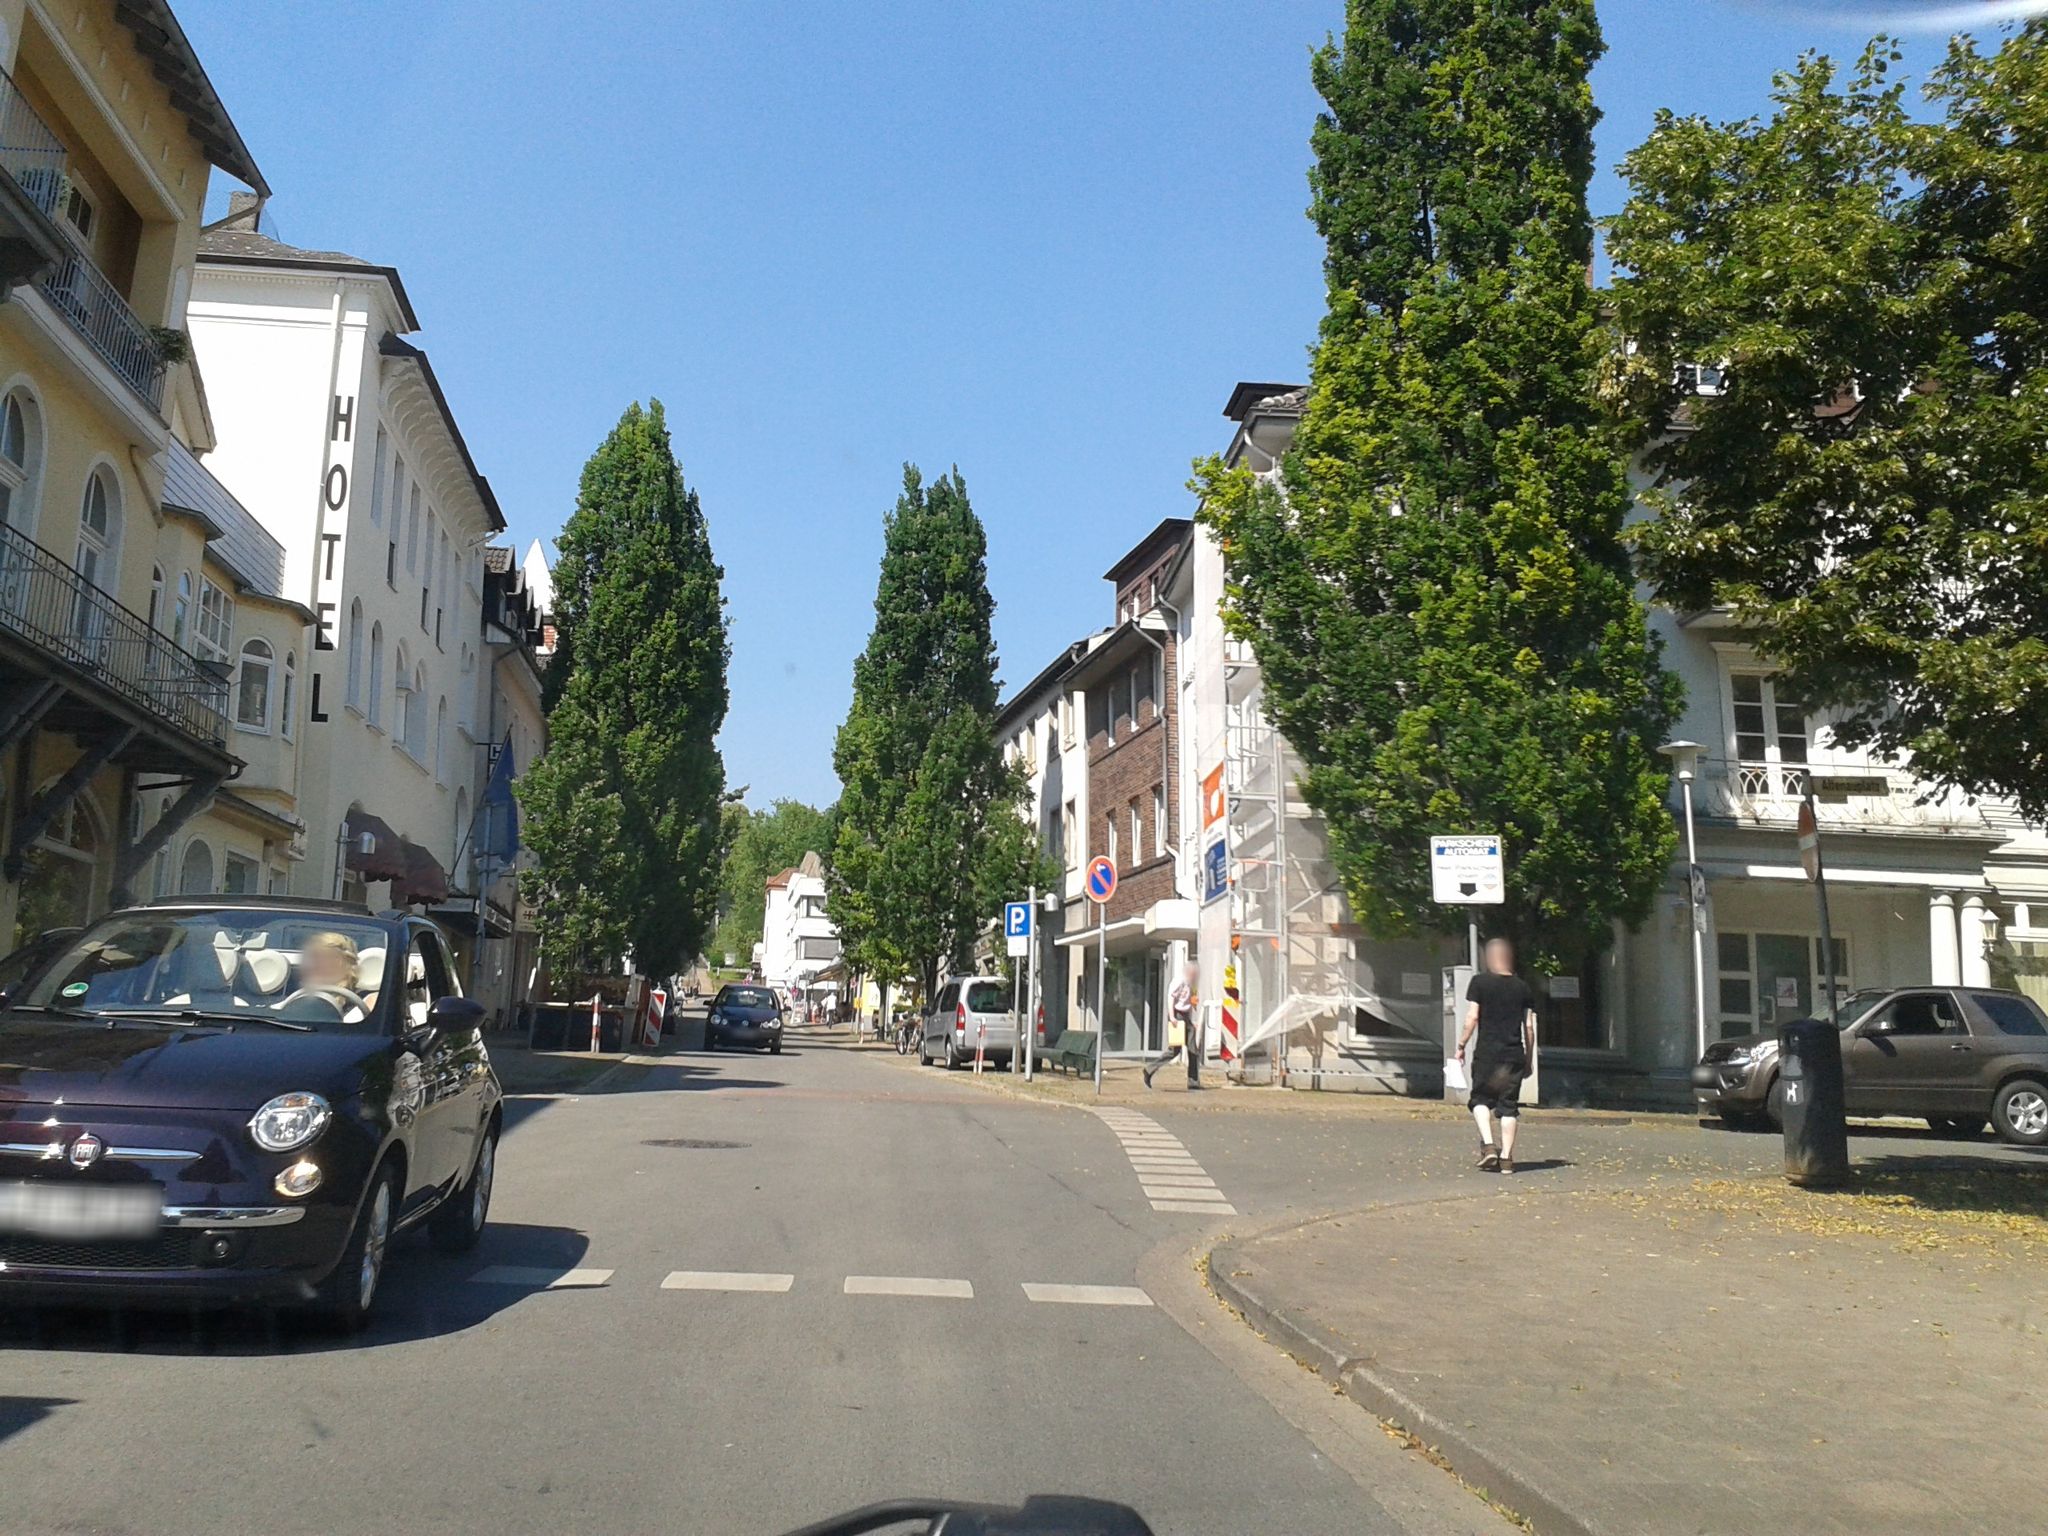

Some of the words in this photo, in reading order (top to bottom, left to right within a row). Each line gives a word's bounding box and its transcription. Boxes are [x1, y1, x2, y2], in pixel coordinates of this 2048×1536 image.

[311, 395, 354, 723] HOTEL
[1443, 847, 1490, 855] AUTOMAT
[1011, 907, 1025, 934] P
[75, 1143, 98, 1159] FIAT
